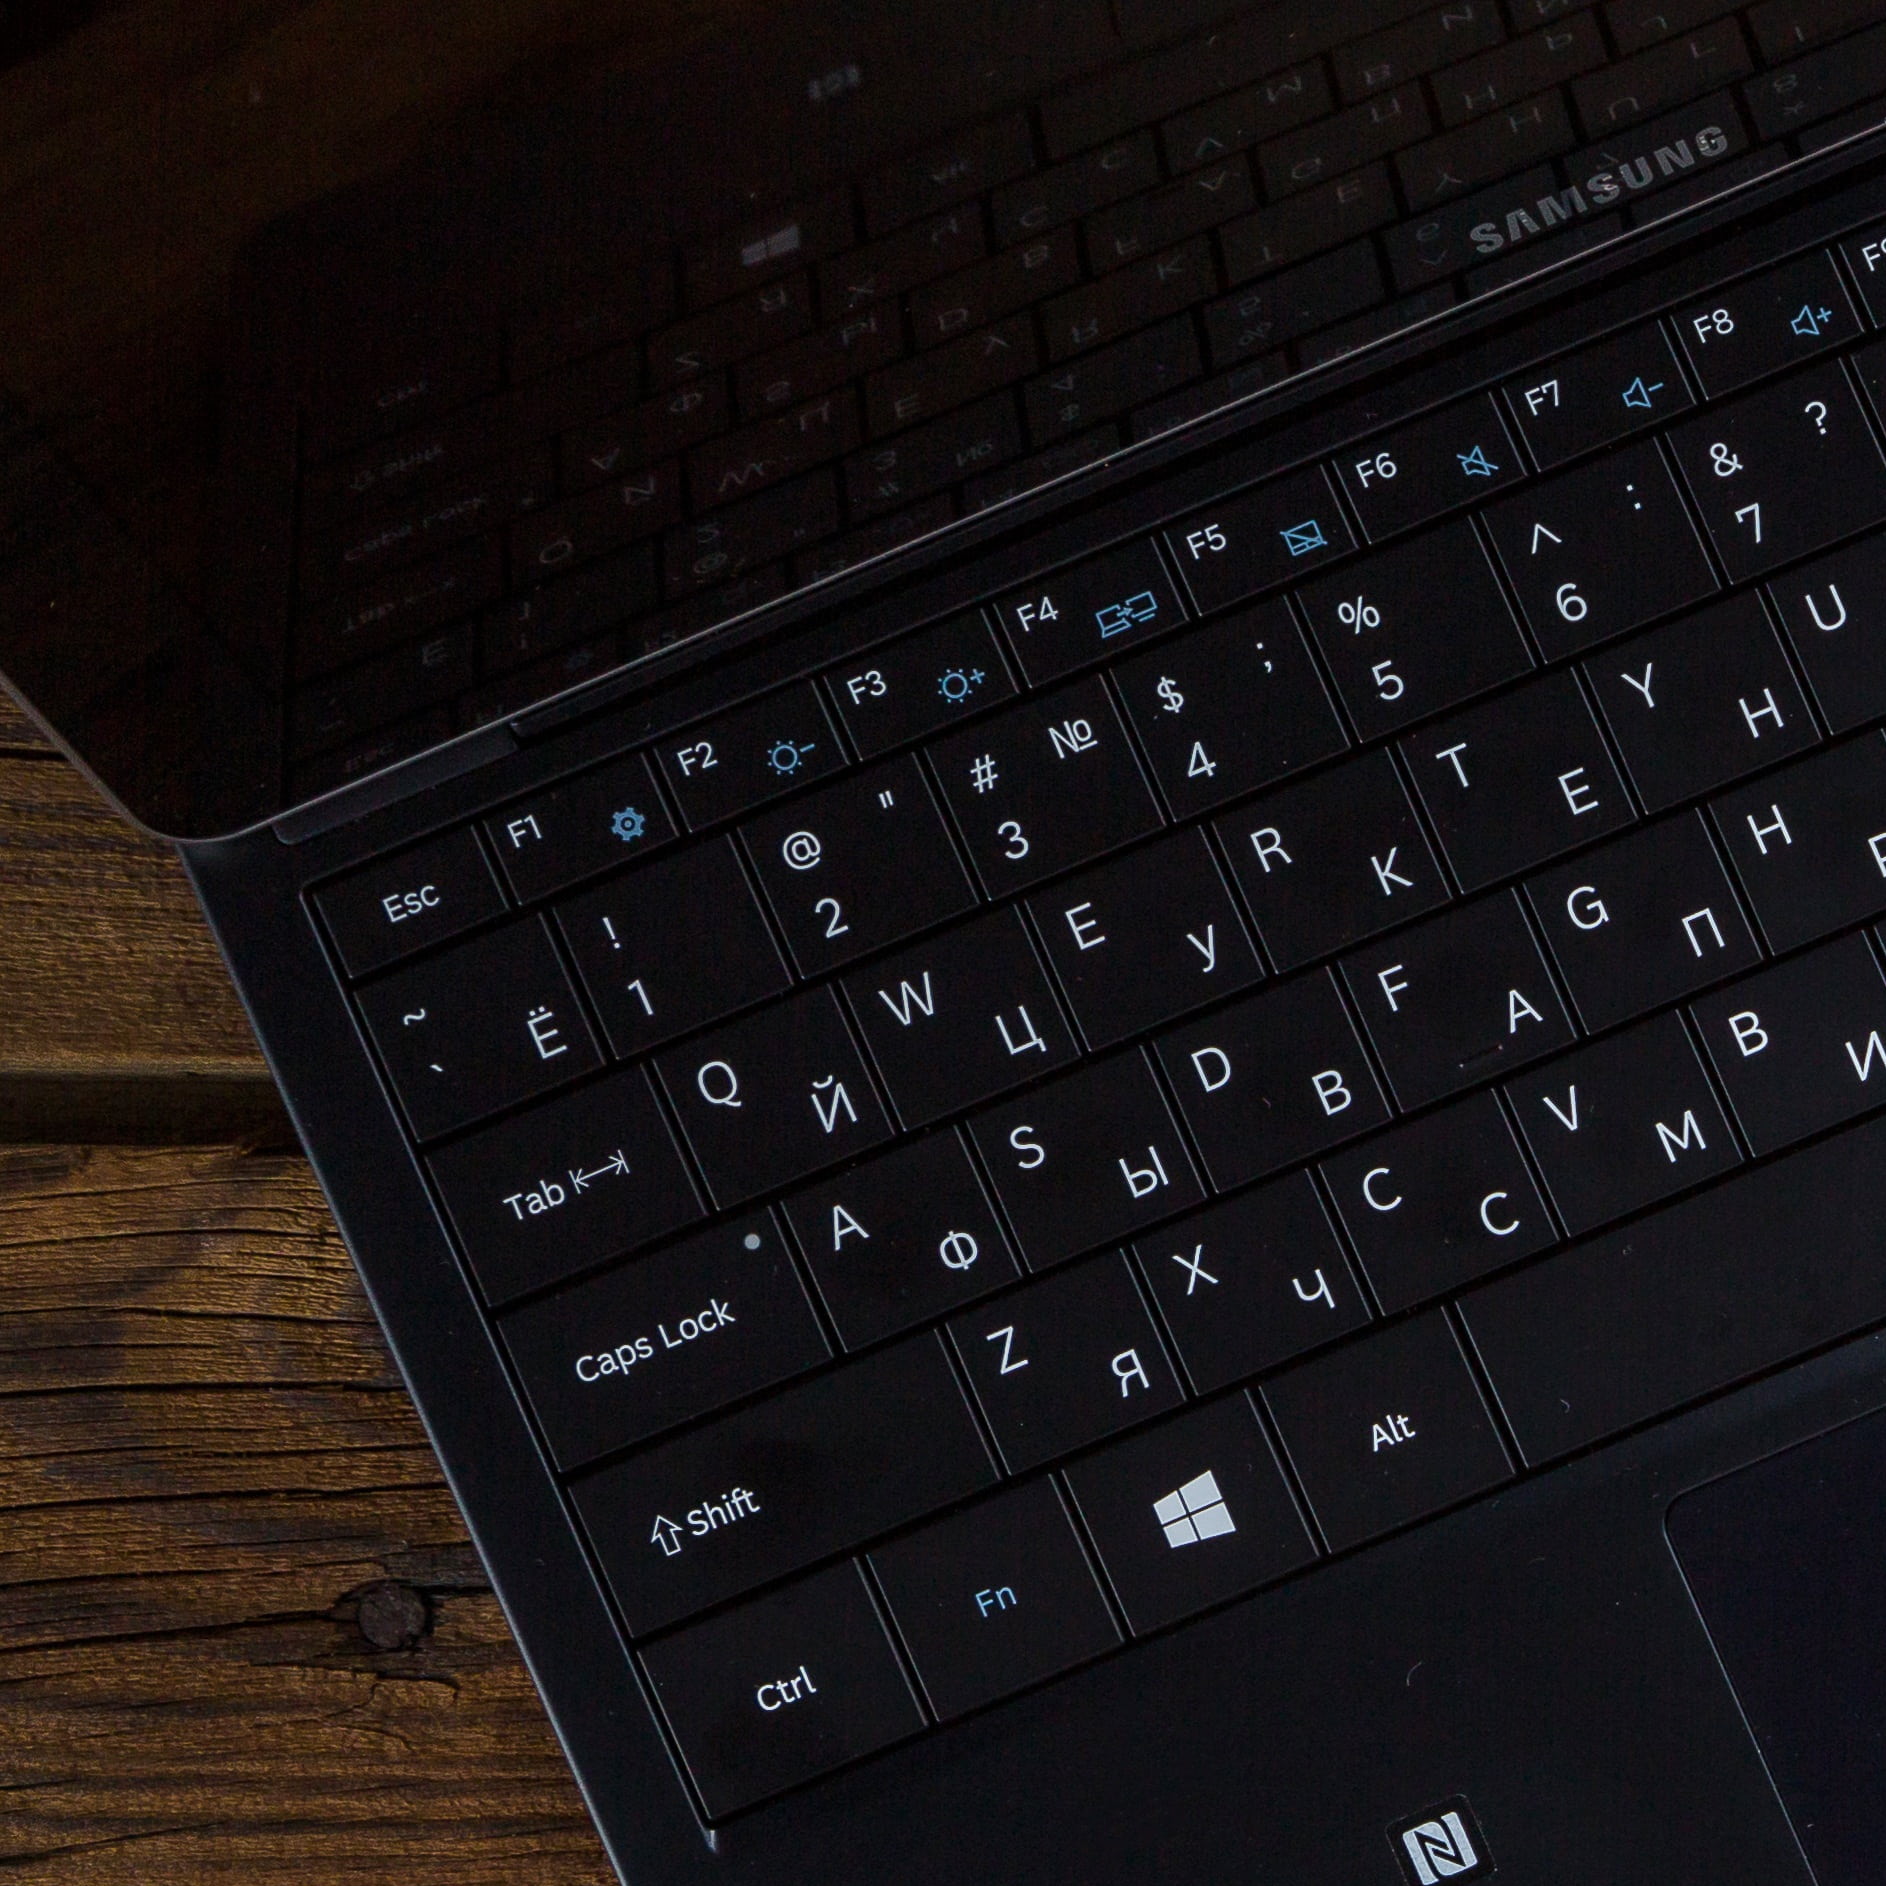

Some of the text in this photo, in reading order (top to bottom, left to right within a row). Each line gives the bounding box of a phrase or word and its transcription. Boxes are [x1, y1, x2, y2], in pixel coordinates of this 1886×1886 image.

[1469, 125, 1729, 254] SAMSUNG
[1692, 308, 1735, 344] F8
[1523, 378, 1560, 417] F7
[1803, 400, 1828, 436] ?
[1354, 451, 1398, 489] F6
[1708, 441, 1744, 478] &
[1185, 523, 1227, 561] F5
[1734, 501, 1762, 545] 7
[1015, 595, 1060, 633] F4
[1336, 594, 1382, 635] %
[1555, 582, 1588, 623] 6
[1804, 583, 1847, 632] U
[846, 669, 888, 705] F3
[1156, 675, 1185, 714] $
[1371, 659, 1405, 701] 5
[1620, 661, 1656, 709] Y
[676, 741, 719, 777] F2
[969, 753, 1000, 795] #
[1186, 740, 1217, 779] 4
[1434, 742, 1470, 788] T
[506, 813, 543, 849] F1
[781, 830, 822, 871] @
[996, 820, 1030, 860] 3
[1249, 826, 1294, 873] R
[1746, 803, 1793, 856] H
[381, 884, 441, 924] Esc
[814, 897, 850, 939] 2
[1566, 885, 1611, 931] G
[601, 916, 622, 950] !
[1064, 901, 1107, 951] E
[627, 978, 655, 1016] 1
[877, 970, 935, 1027] W
[1377, 963, 1409, 1013] F
[1727, 1010, 1769, 1058] B
[696, 1060, 743, 1108] Q
[1190, 1046, 1233, 1094] D
[1541, 1084, 1579, 1132] V
[1009, 1125, 1046, 1170] S
[501, 1179, 567, 1221] Tab
[1362, 1167, 1403, 1212] C
[832, 1204, 871, 1252] A
[1171, 1243, 1220, 1296] X
[575, 1298, 737, 1383] Caps Lock
[985, 1324, 1030, 1376] Z
[1371, 1413, 1417, 1453] Alt
[685, 1486, 762, 1537] Shift
[974, 1586, 1018, 1618] Fn
[756, 1665, 818, 1712] Ctrl
